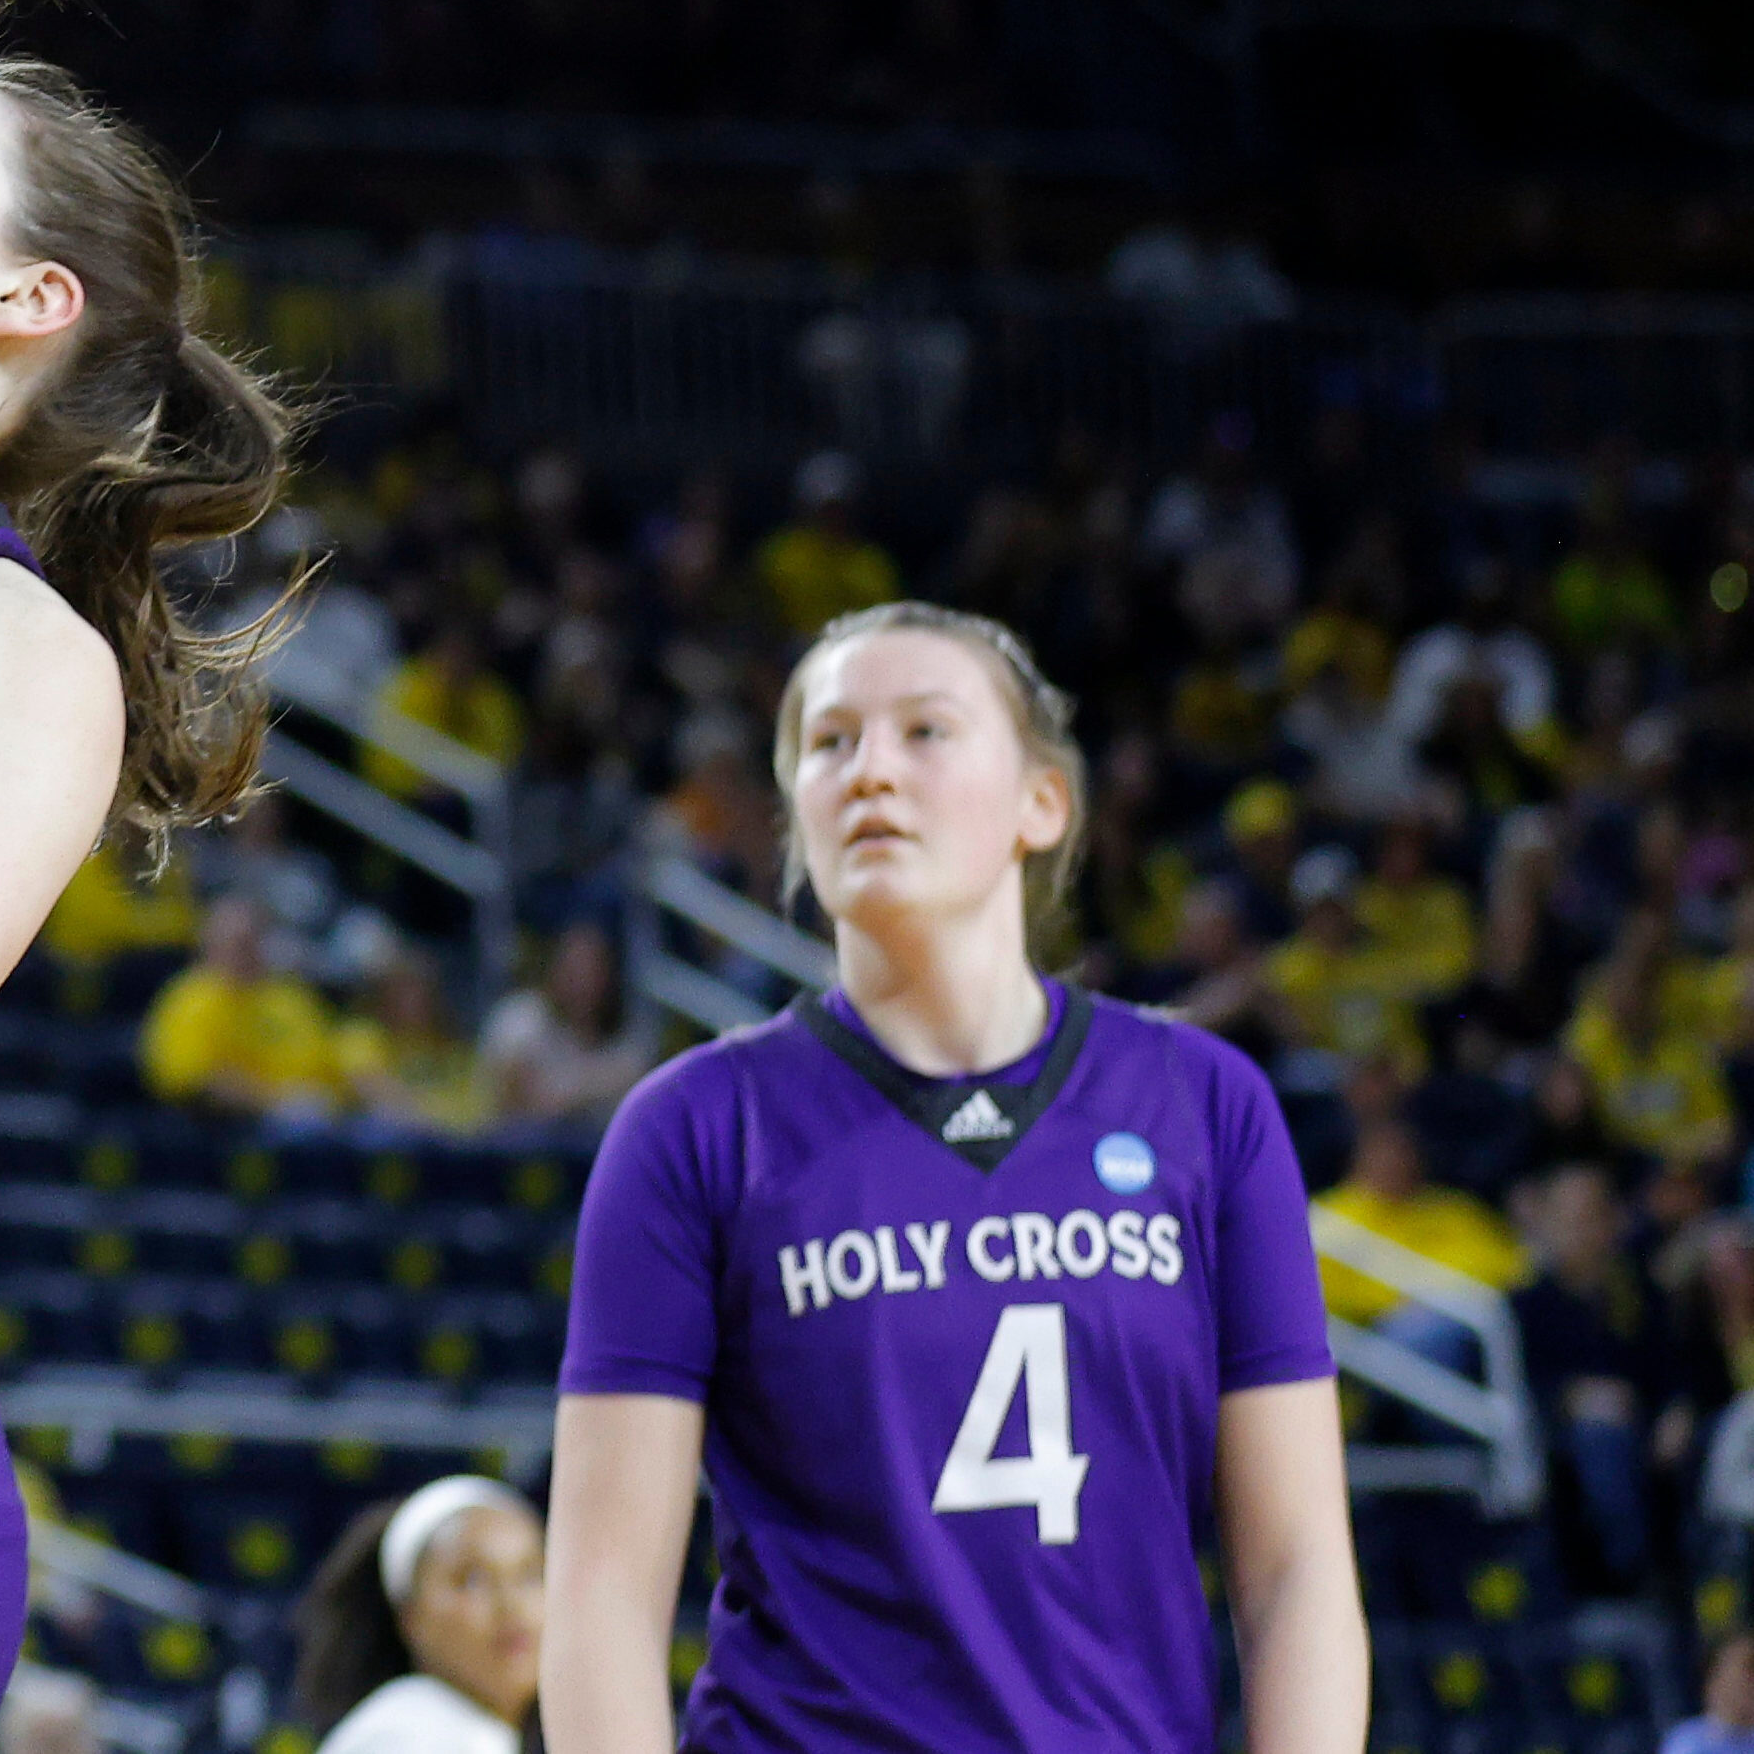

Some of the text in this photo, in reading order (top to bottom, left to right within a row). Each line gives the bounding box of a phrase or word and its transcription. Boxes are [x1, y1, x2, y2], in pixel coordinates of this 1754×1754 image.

[778, 1208, 1185, 1319] HOLY CROSS
[931, 1301, 1091, 1545] 4
